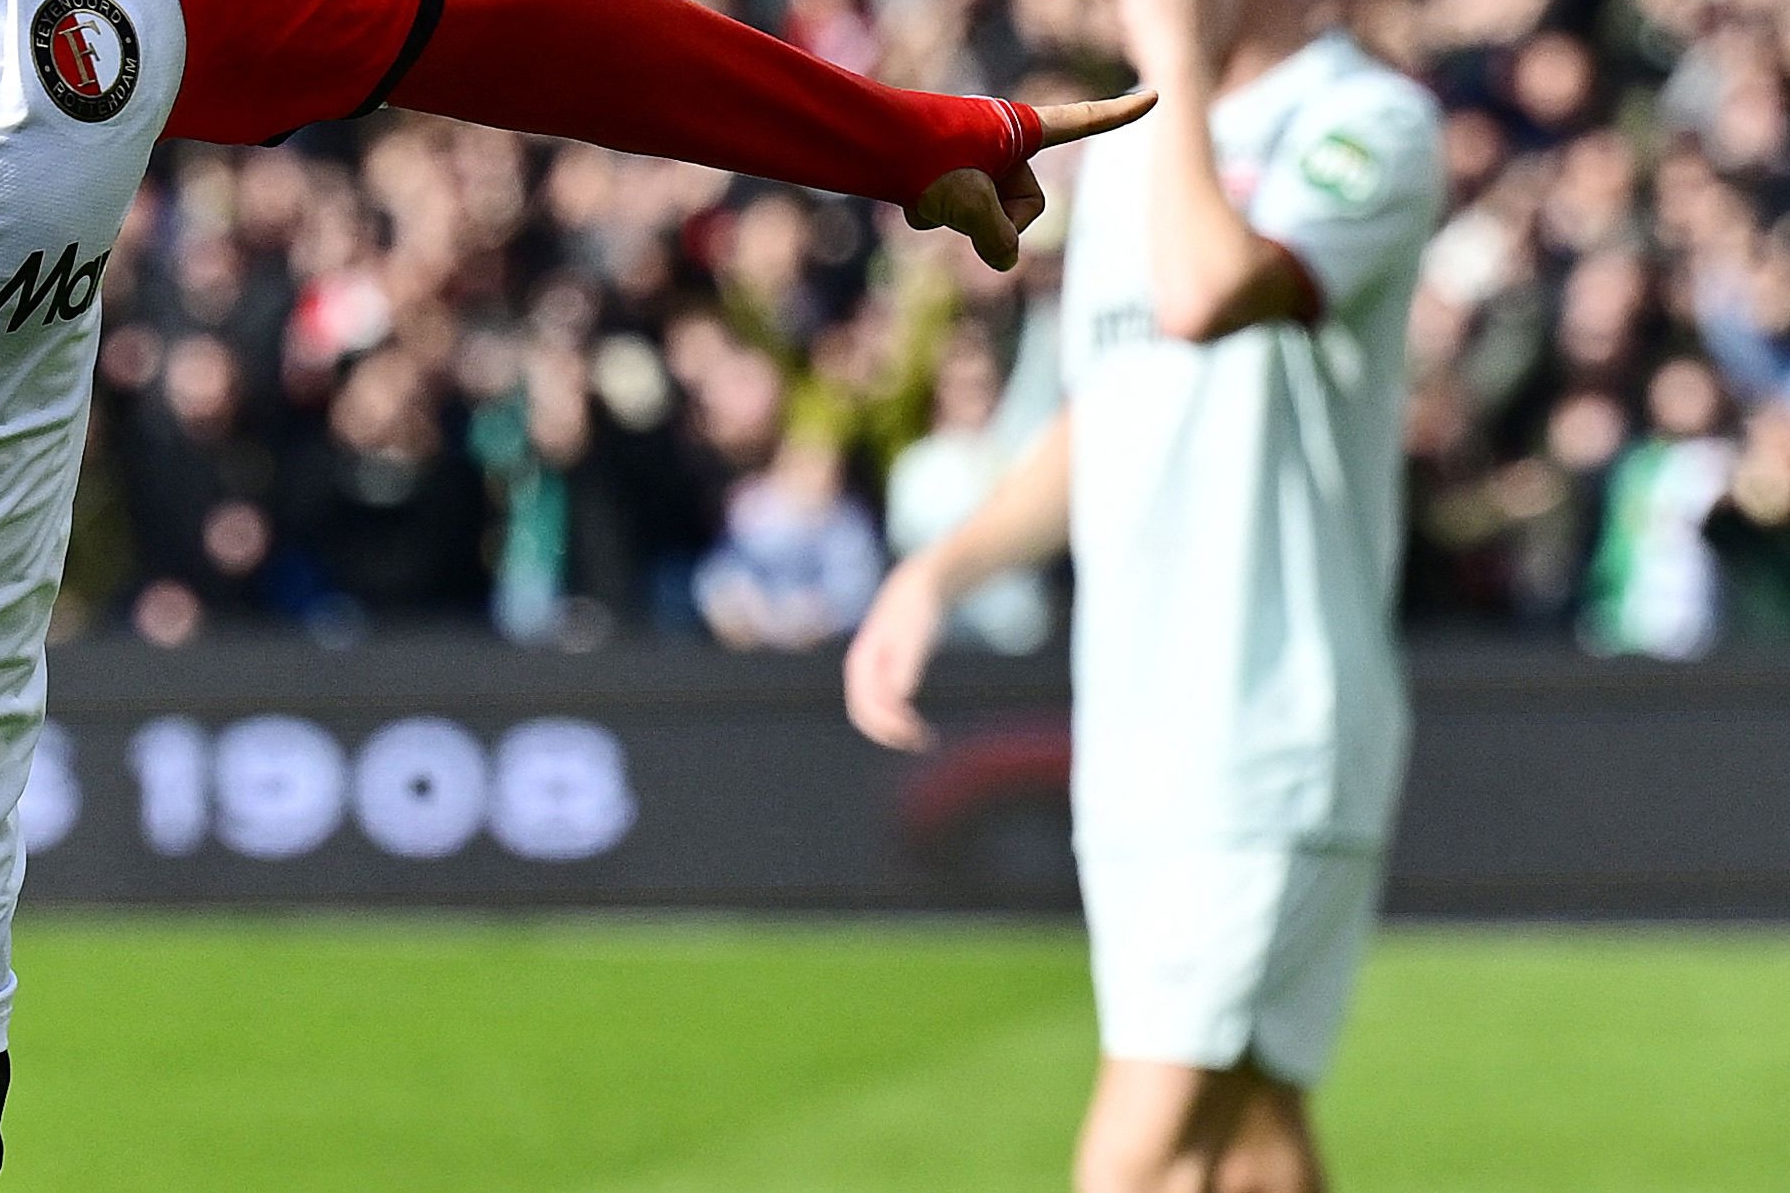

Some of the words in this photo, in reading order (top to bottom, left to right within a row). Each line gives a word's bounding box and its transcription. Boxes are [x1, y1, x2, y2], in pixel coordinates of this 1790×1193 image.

[53, 57, 138, 115] ROTTERDAM
[58, 20, 101, 87] F
[127, 713, 640, 861] 1908
